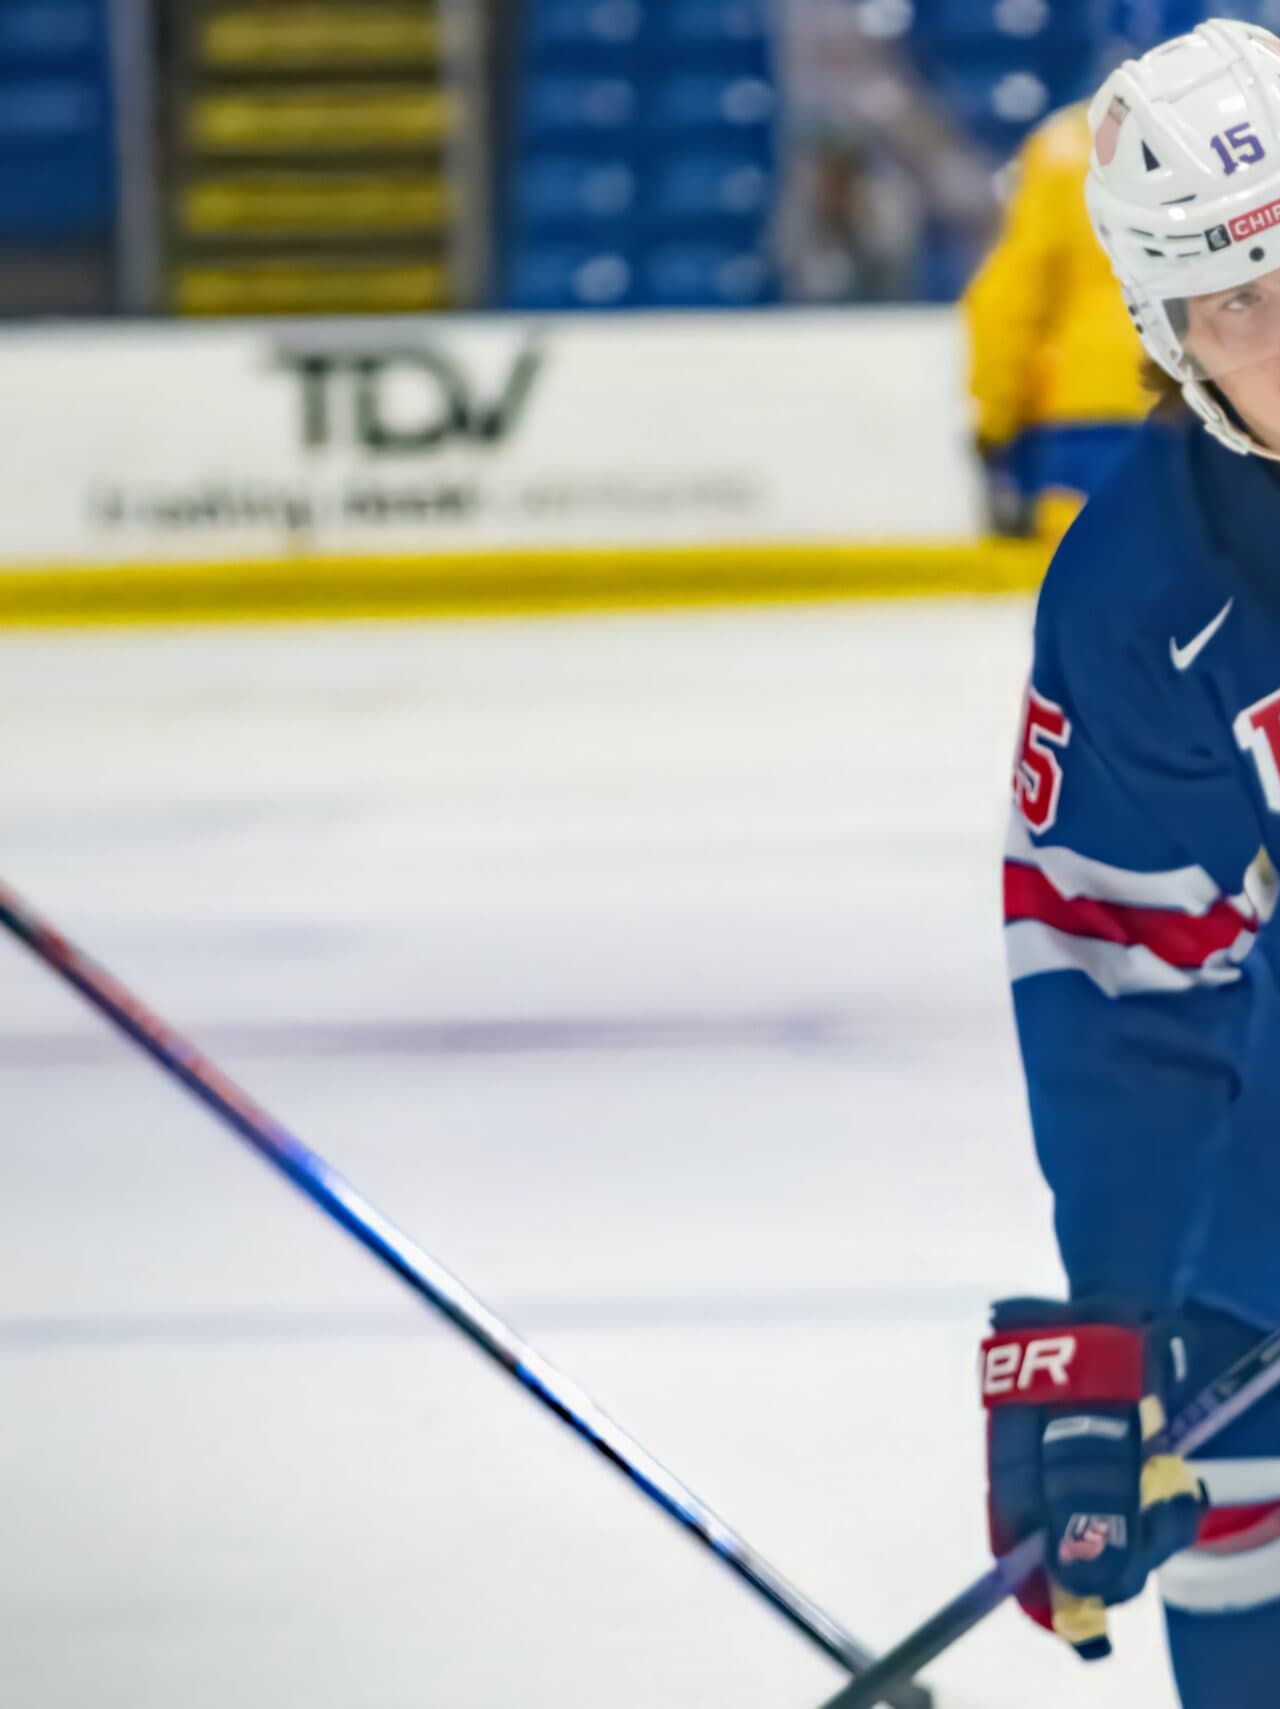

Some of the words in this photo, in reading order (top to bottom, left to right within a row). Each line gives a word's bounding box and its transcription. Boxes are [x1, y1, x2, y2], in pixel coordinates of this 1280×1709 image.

[1210, 122, 1266, 175] 15
[266, 334, 546, 456] TDV
[1012, 688, 1072, 836] 5
